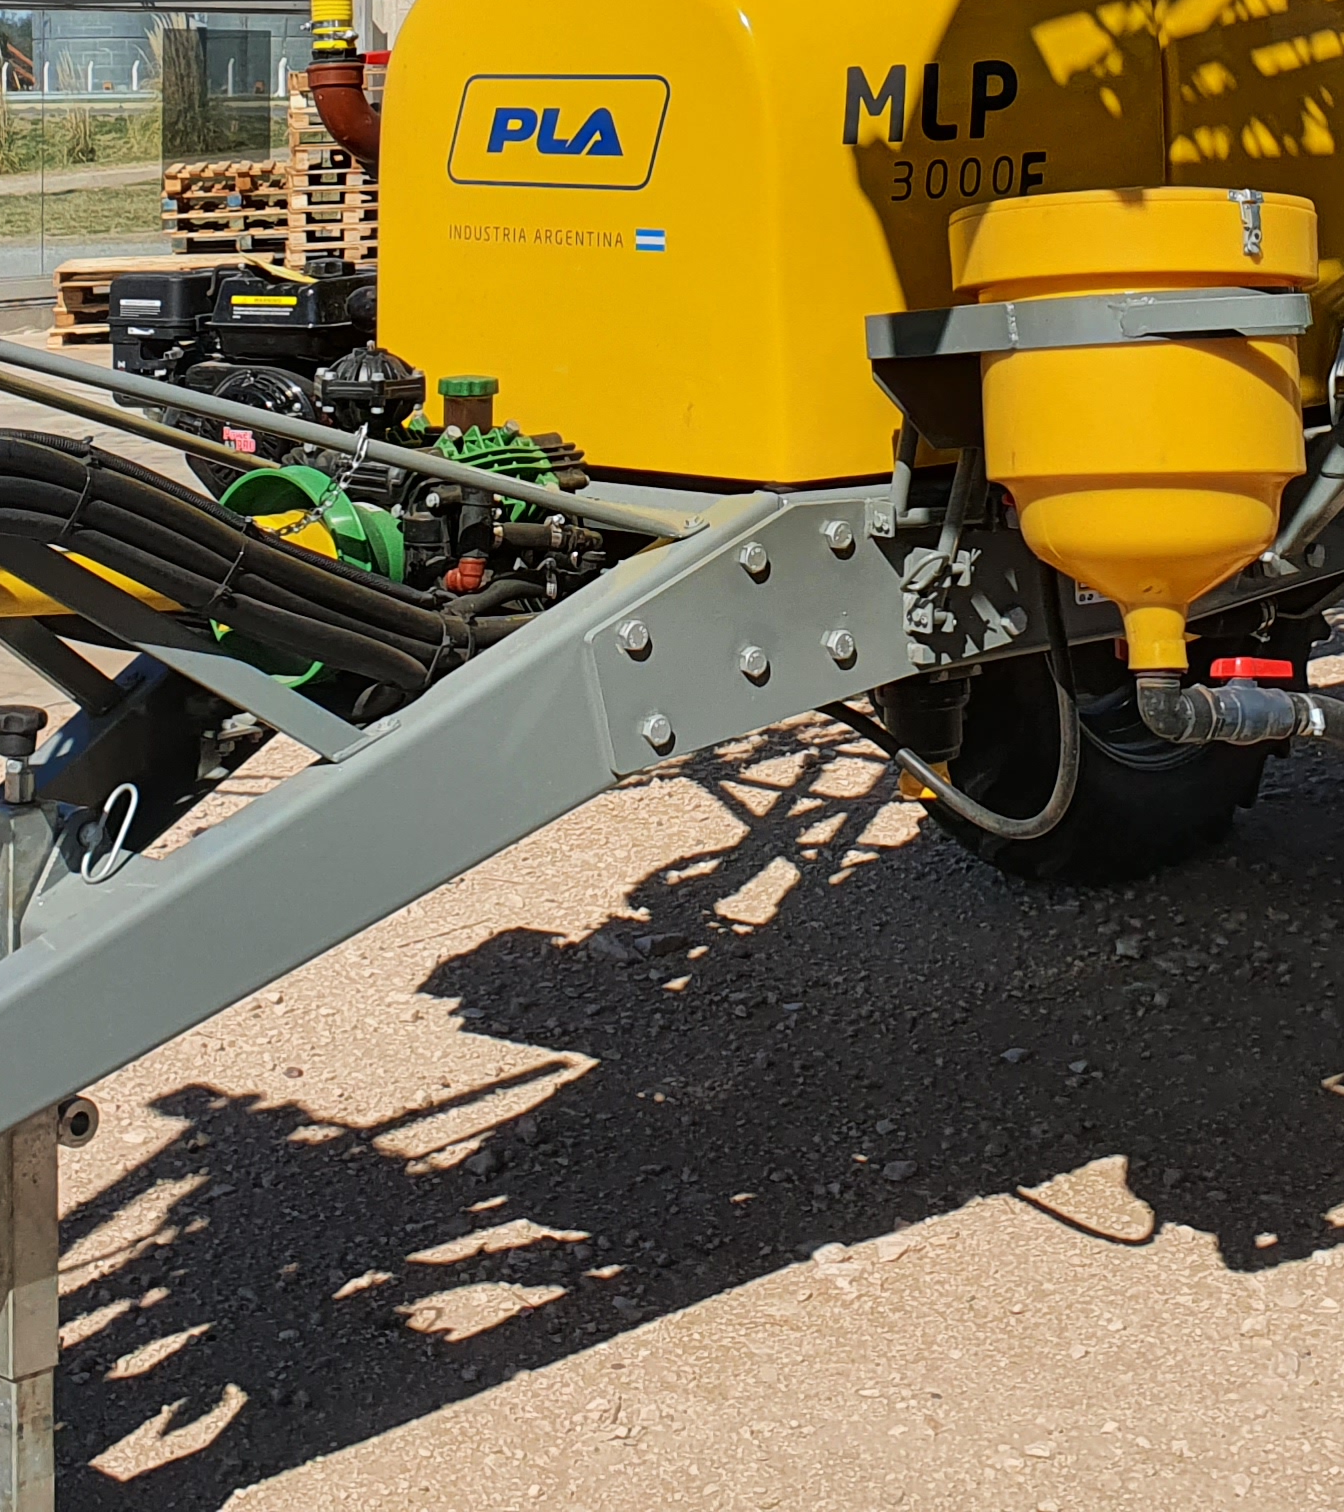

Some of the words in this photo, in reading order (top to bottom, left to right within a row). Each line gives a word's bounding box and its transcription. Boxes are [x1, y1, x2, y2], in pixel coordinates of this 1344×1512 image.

[842, 60, 1018, 145] MLP
[486, 107, 624, 156] PLA
[448, 224, 526, 243] INDUSTRIA
[533, 228, 624, 248] ARGENTINA
